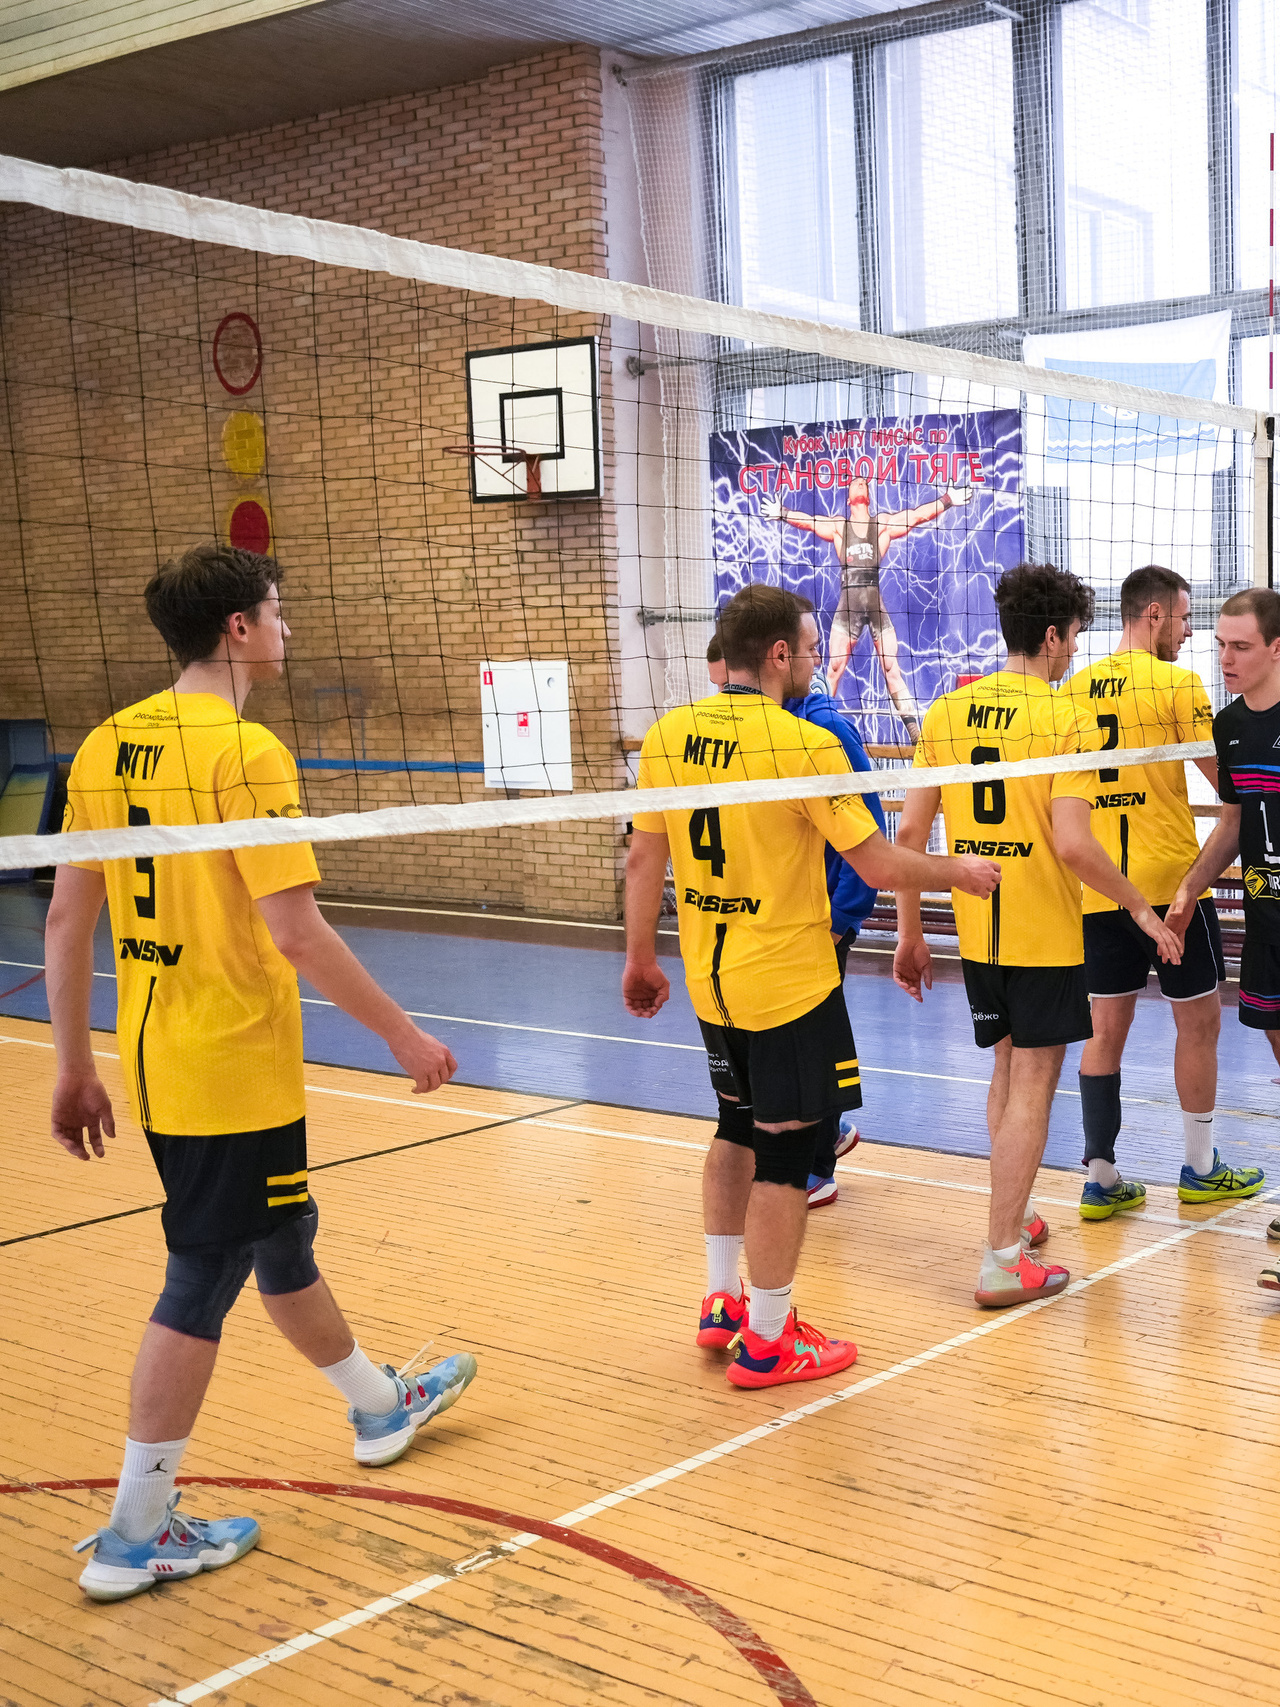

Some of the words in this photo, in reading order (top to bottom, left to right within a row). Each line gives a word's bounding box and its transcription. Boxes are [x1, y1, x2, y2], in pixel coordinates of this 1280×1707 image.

[783, 436, 824, 456] Кубок
[829, 431, 865, 450] НИТУ
[872, 428, 923, 447] МИСиС
[930, 430, 948, 445] по
[739, 449, 897, 494] СТАНОВОЙ
[909, 453, 985, 485] ТЯГЕ
[1089, 676, 1127, 698] МГТУ
[967, 704, 1018, 729] МГТУ
[683, 734, 738, 769] МГТУ
[1097, 714, 1119, 783] 2
[971, 746, 1006, 824] 6
[1095, 792, 1146, 809] NSEN
[688, 806, 726, 879] 4
[954, 839, 1033, 857] ENSEN
